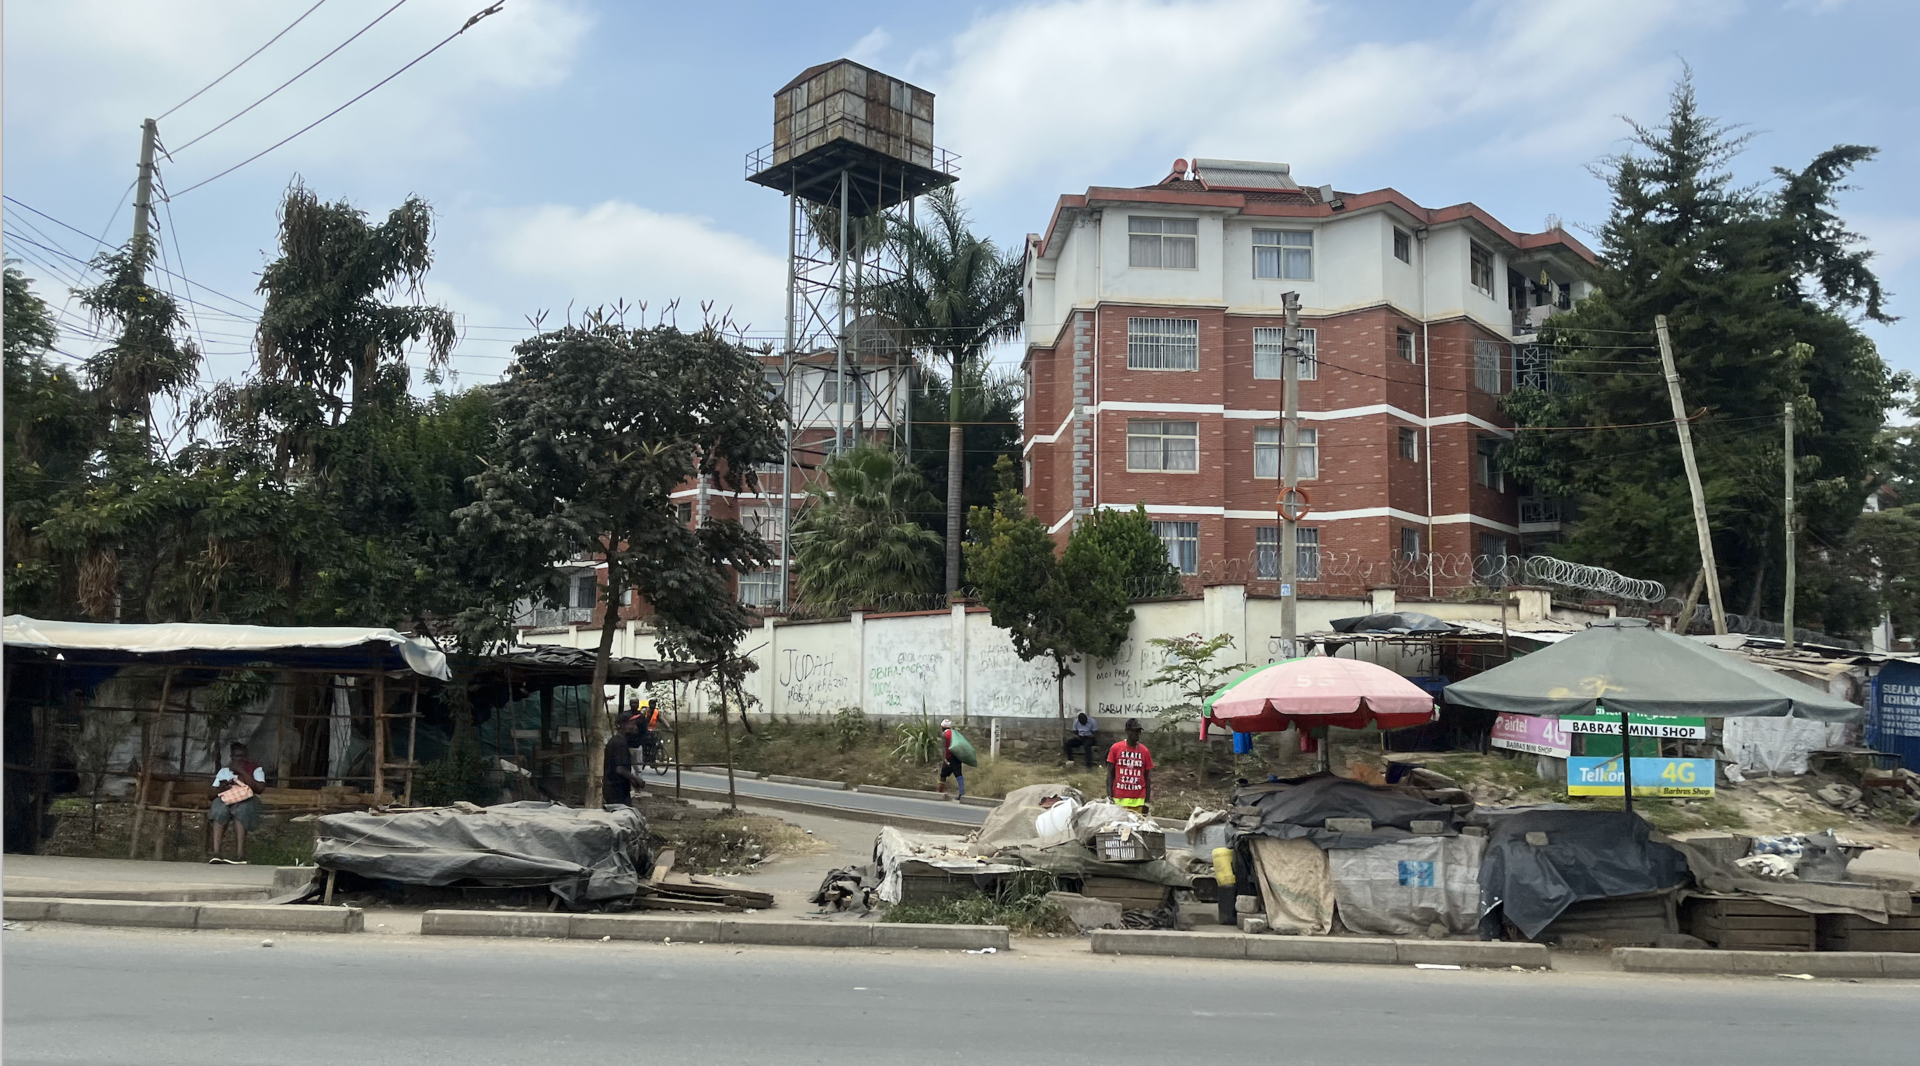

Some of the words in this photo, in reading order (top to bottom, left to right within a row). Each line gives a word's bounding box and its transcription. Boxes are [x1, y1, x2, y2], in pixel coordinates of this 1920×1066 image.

[780, 648, 833, 687] JUDAH
[1504, 715, 1527, 733] airtel
[1542, 721, 1567, 746] 4G
[1572, 721, 1624, 734] BABRA'S
[1629, 725, 1658, 736] MINI
[1662, 726, 1695, 737] SHOP
[1526, 744, 1537, 752] MINI
[1537, 746, 1553, 754] SHOP
[1121, 751, 1142, 759] SKATE
[1119, 768, 1141, 776] NEVER
[1662, 762, 1695, 783] 4G
[1121, 776, 1138, 784] STOP
[1692, 787, 1711, 796] Shop
